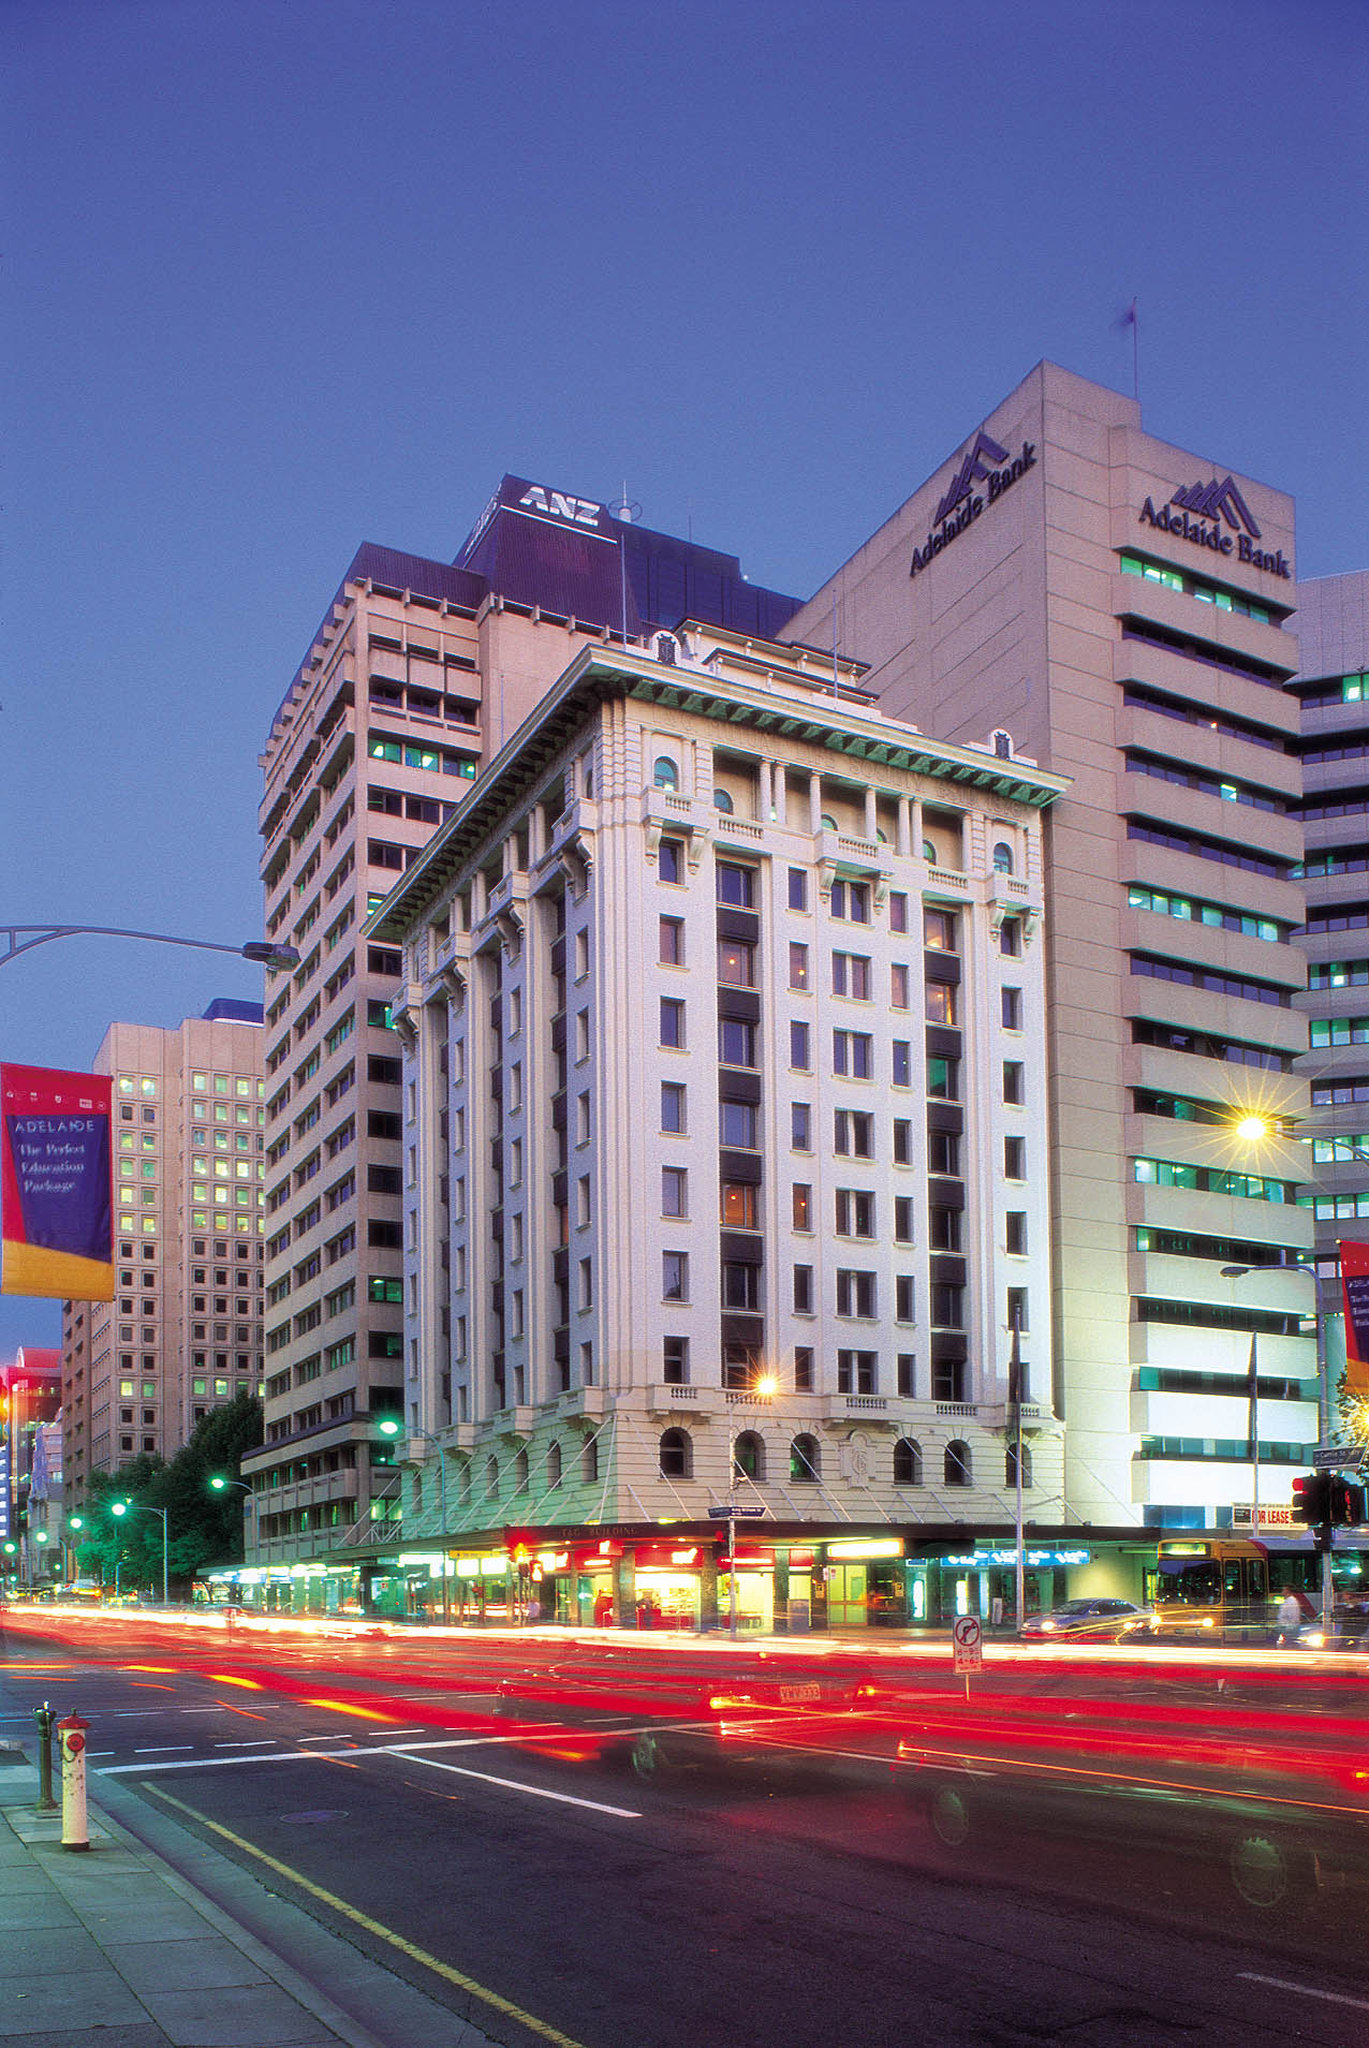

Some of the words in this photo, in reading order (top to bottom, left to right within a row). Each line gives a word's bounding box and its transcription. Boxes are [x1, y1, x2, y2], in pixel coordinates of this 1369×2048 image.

[518, 485, 601, 528] ANZ
[910, 494, 985, 579] Adelaide
[987, 440, 1038, 505] Bank
[1138, 495, 1234, 556] Adelaide
[1236, 532, 1291, 580] Bank
[15, 1120, 96, 1134] ADELAIDE
[17, 1143, 42, 1157] The
[45, 1142, 86, 1157] Perfect
[20, 1160, 85, 1175] Education
[23, 1179, 77, 1194] Package
[1267, 1509, 1290, 1524] LEASE
